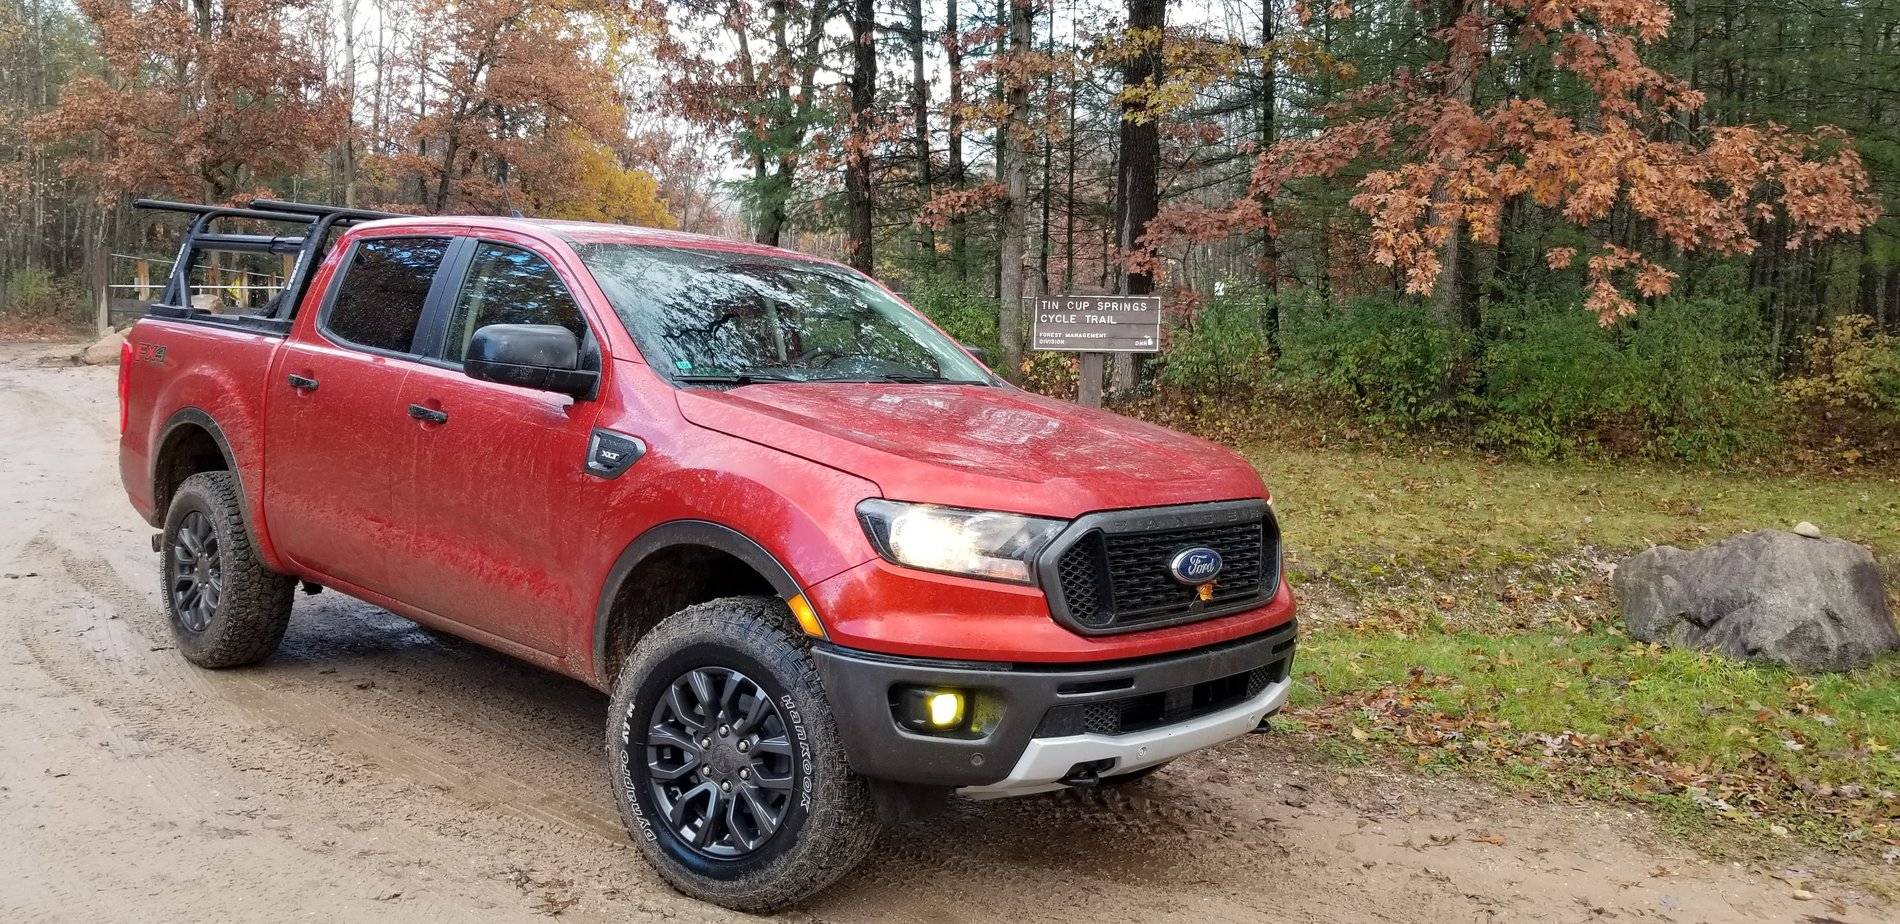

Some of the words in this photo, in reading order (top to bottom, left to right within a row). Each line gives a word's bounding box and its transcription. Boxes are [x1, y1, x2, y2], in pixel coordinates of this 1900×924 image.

[1041, 300, 1059, 310] TIN
[1067, 301, 1090, 311] CUP
[1097, 302, 1147, 312] SPRINGS
[1040, 314, 1077, 324] CYCLE
[1085, 314, 1117, 324] TRAIL
[137, 341, 167, 363] FX4
[601, 450, 620, 460] XLT
[1188, 554, 1215, 576] Ford
